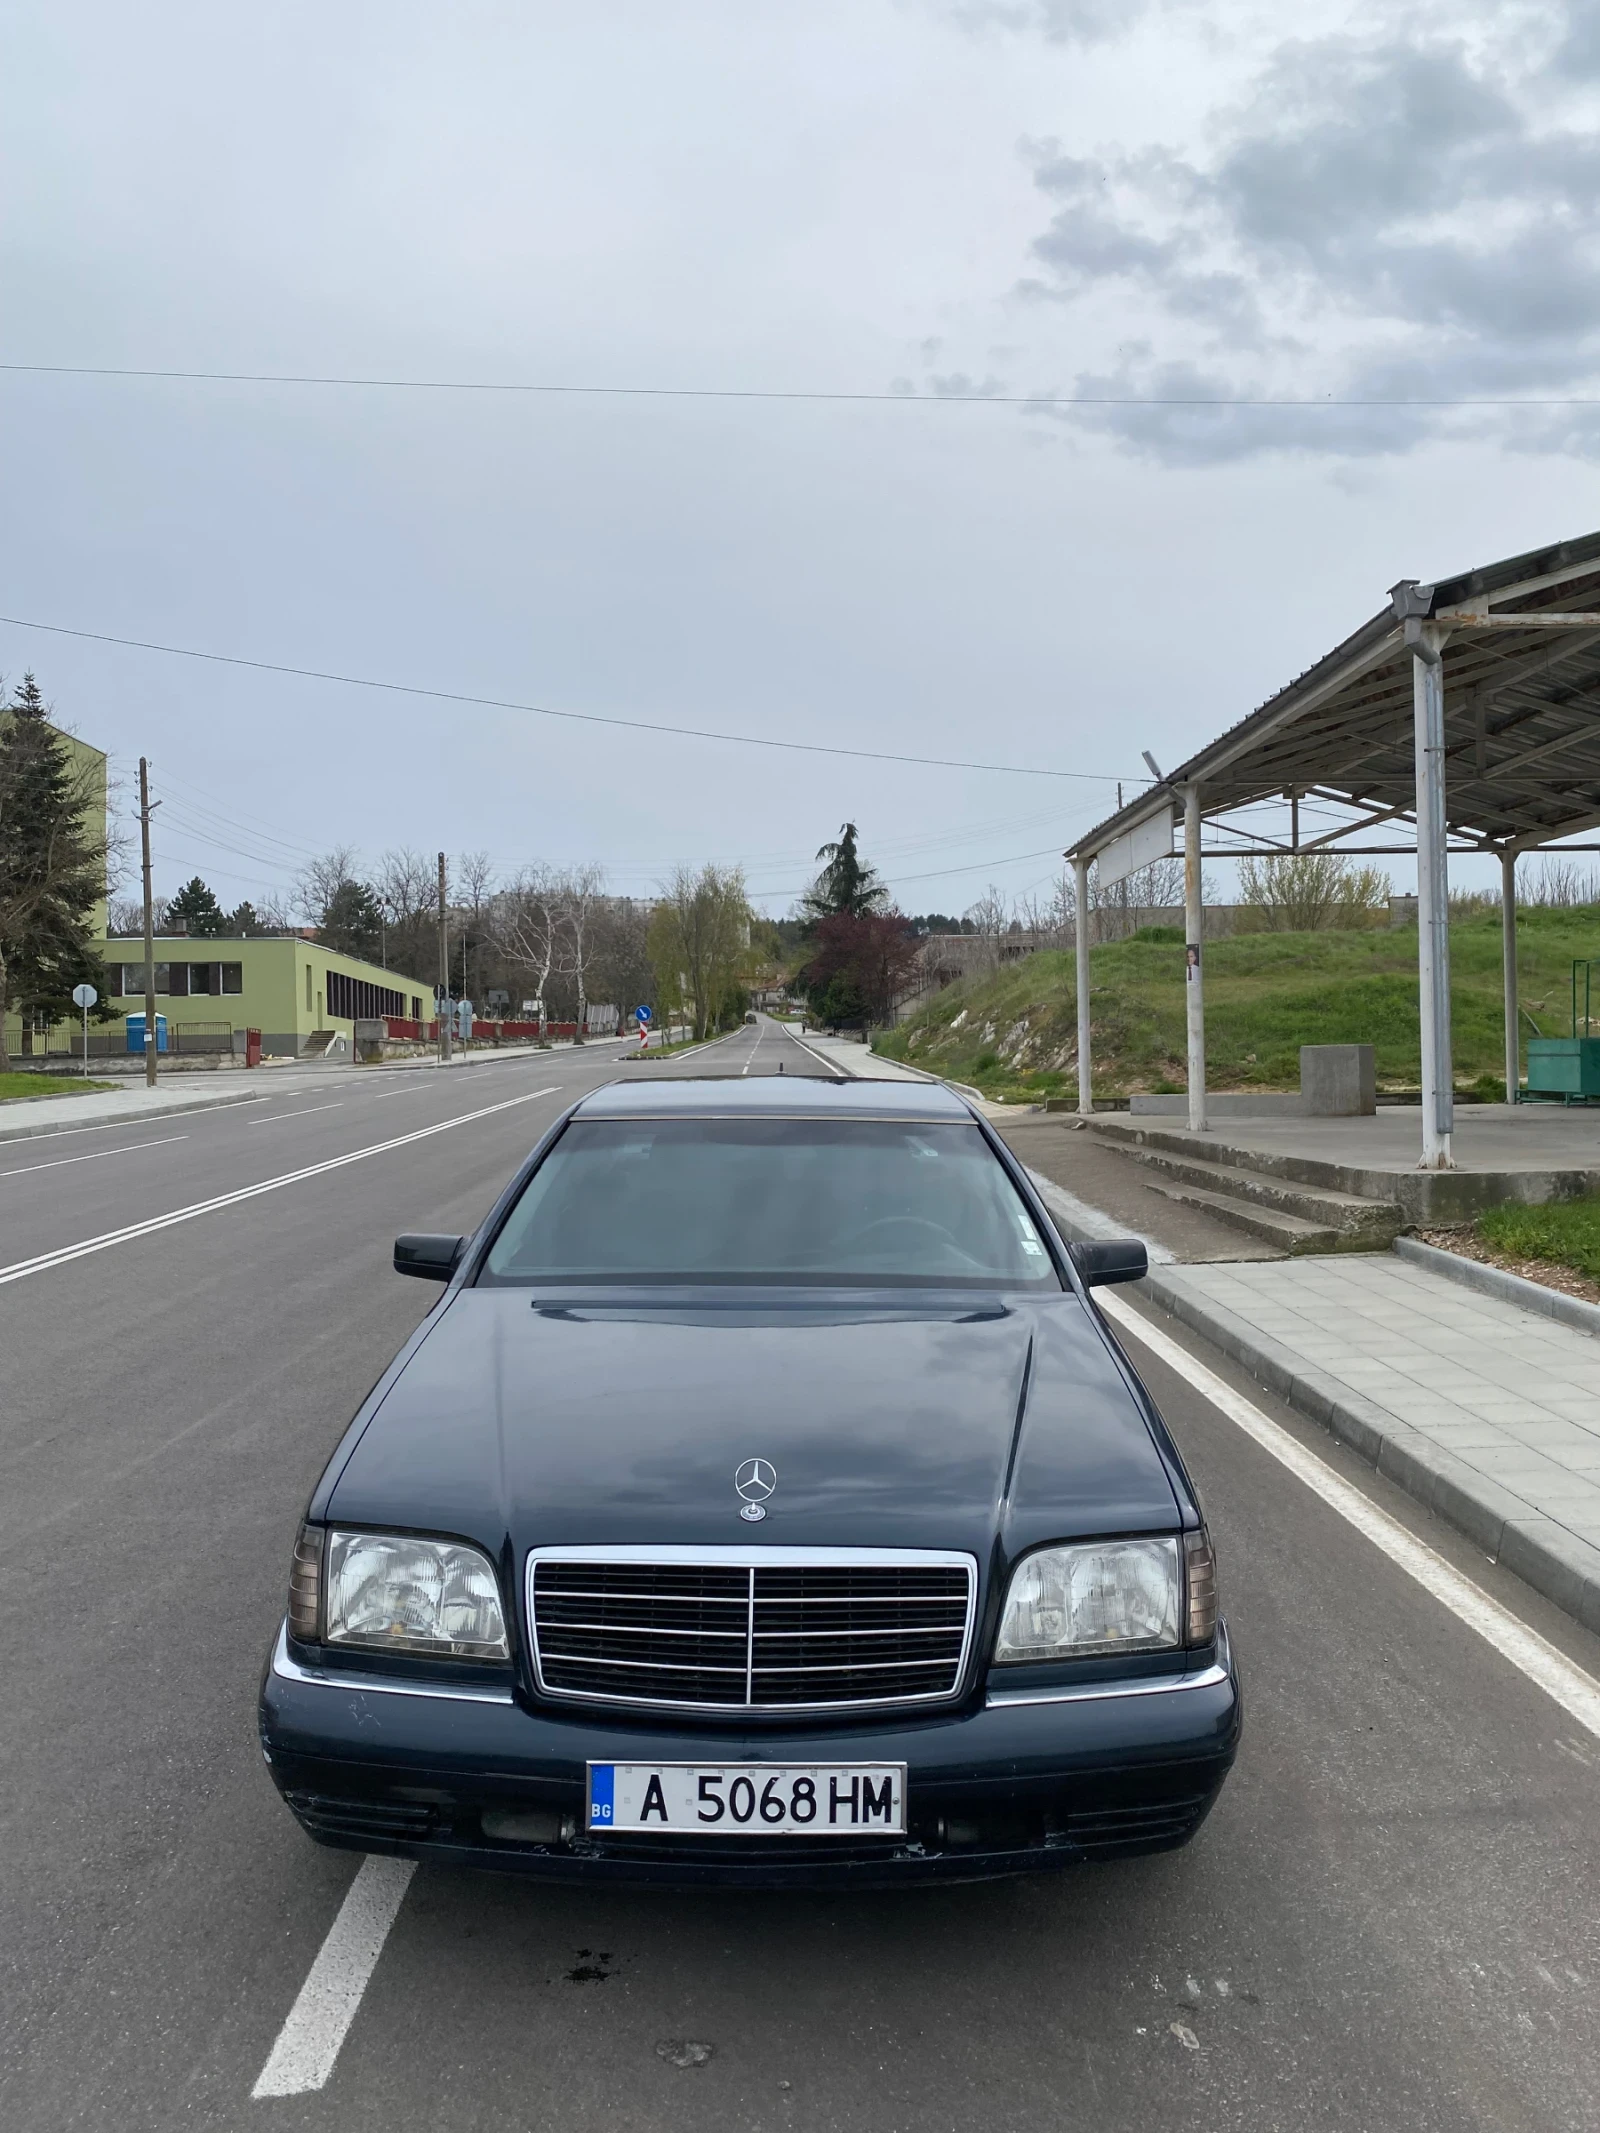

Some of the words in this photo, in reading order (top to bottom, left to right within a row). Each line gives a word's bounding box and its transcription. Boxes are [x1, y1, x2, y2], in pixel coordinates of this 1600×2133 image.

[591, 1803, 612, 1819] BG
[639, 1774, 669, 1822] A
[697, 1775, 818, 1824] 5068
[828, 1775, 893, 1824] HM
